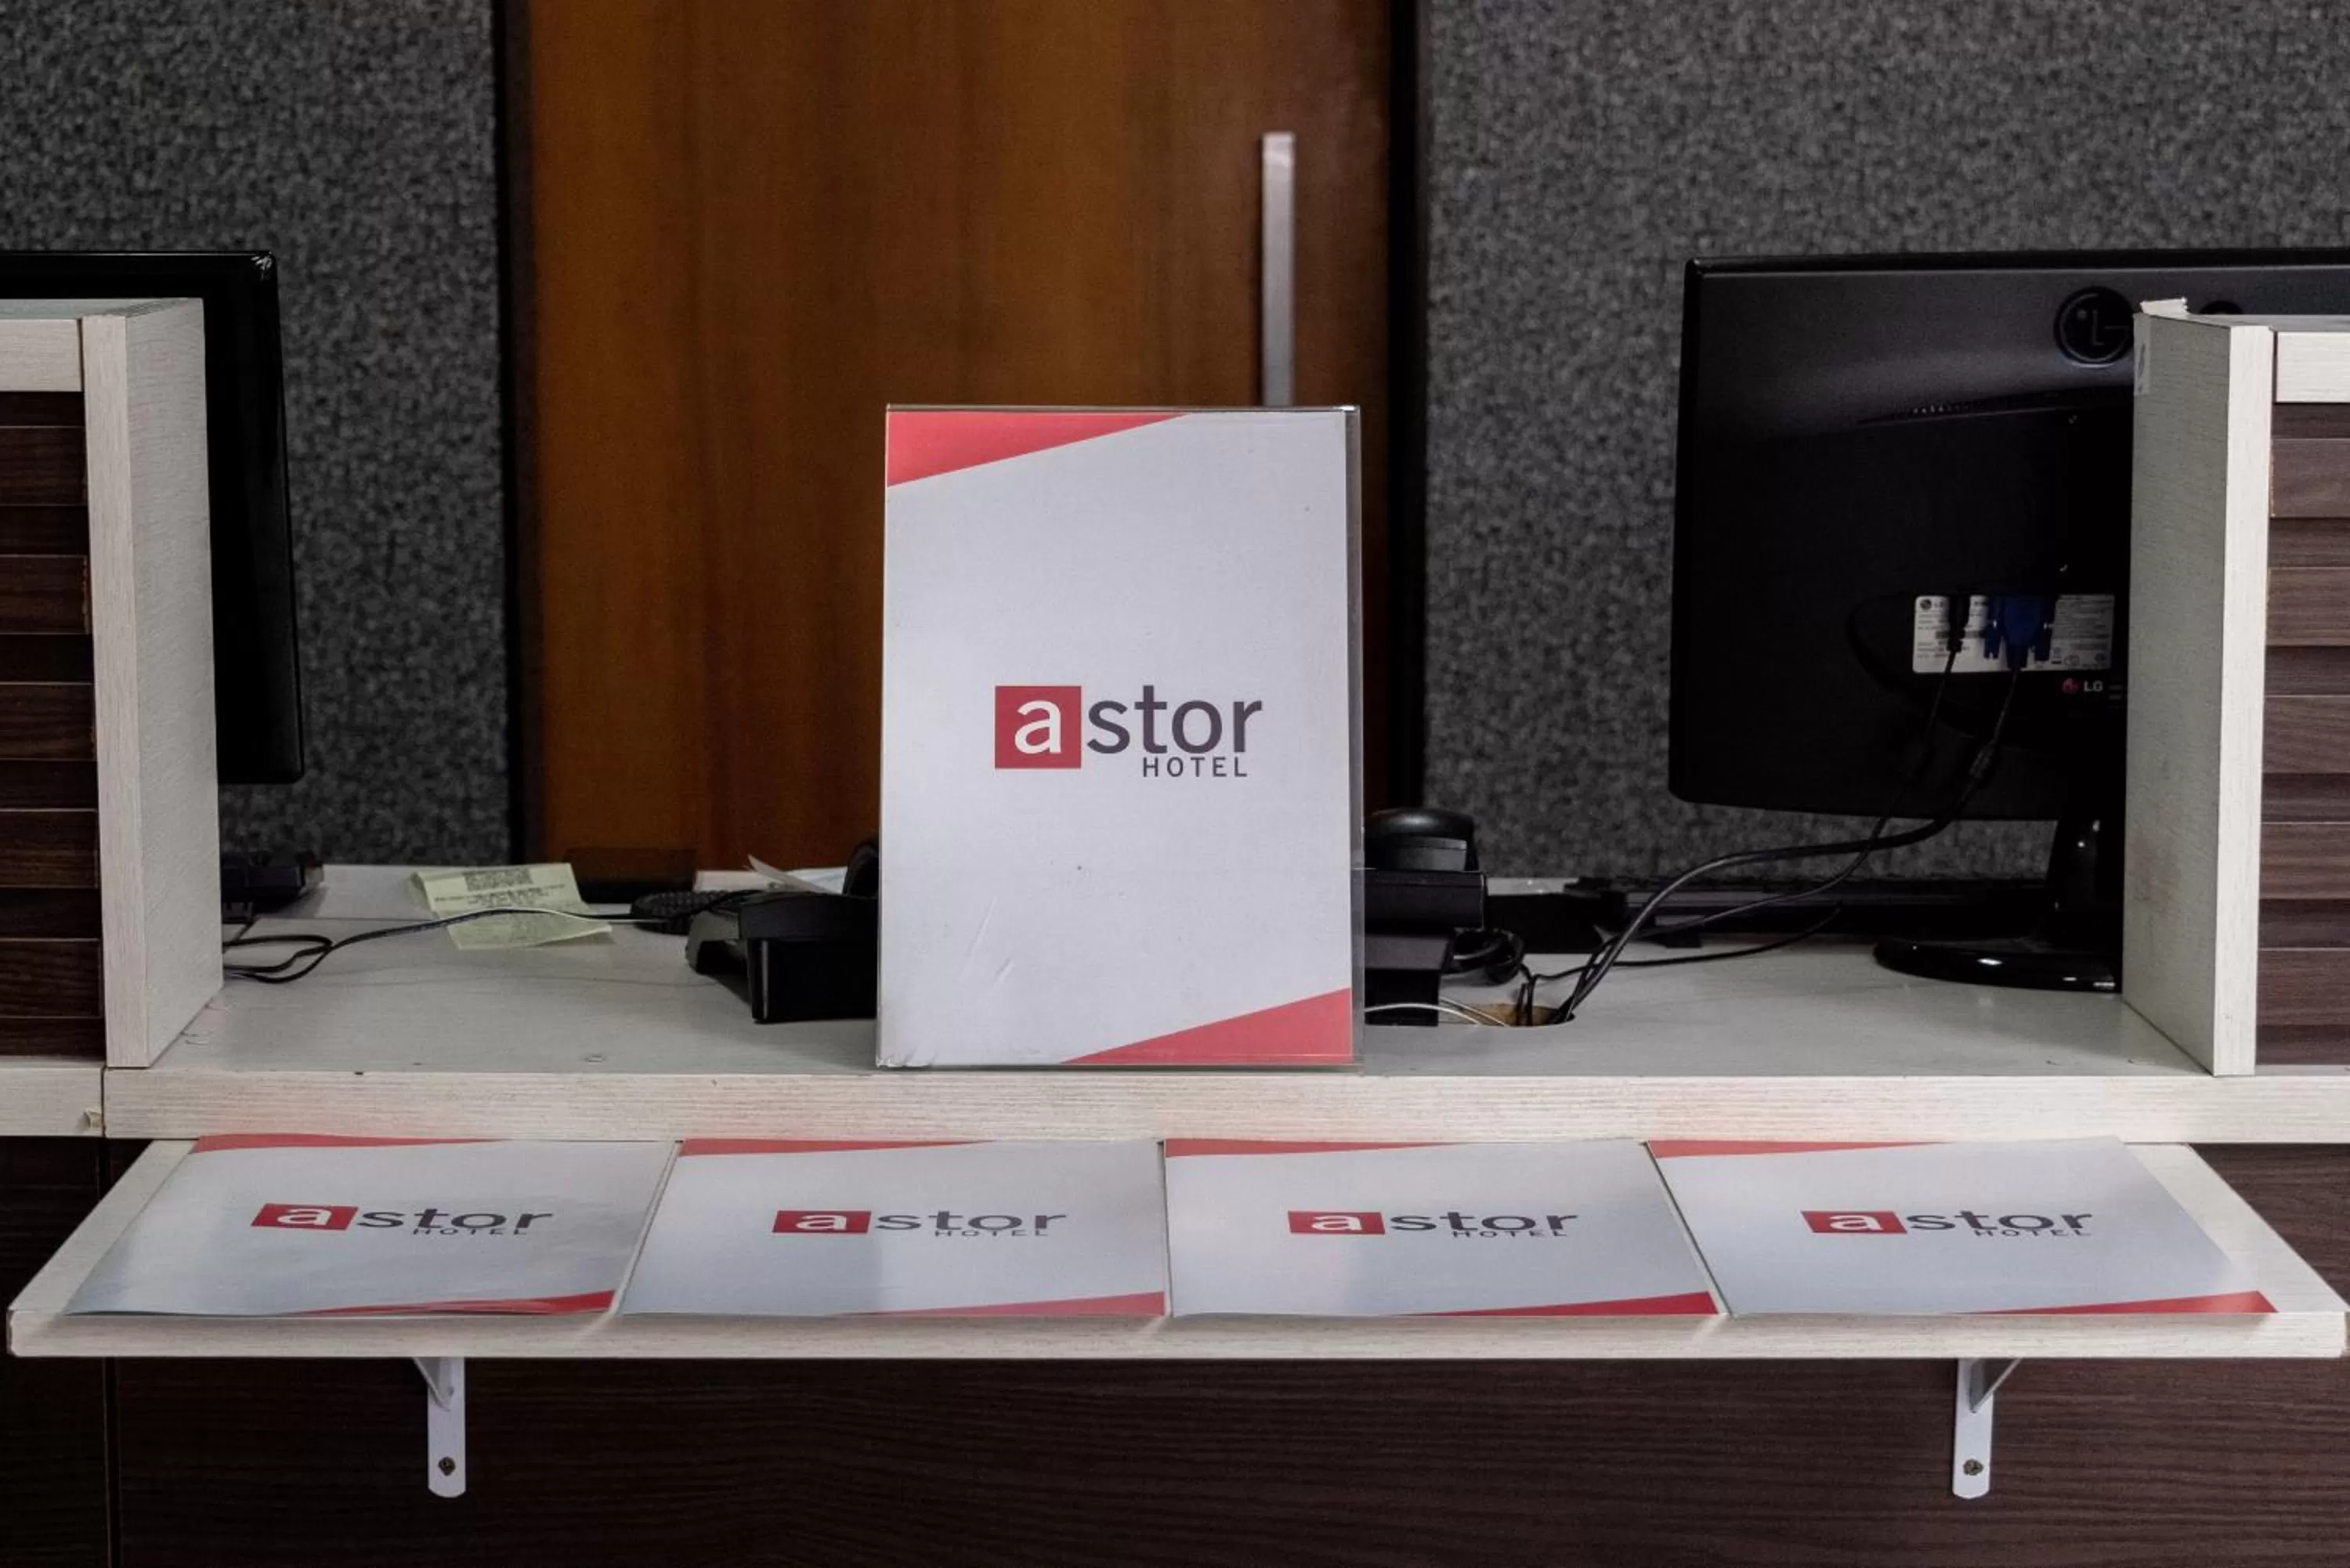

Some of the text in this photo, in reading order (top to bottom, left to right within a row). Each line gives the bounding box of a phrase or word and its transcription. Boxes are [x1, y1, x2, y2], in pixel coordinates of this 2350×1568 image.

[2084, 680, 2103, 692] LG
[1014, 685, 1263, 754] astor
[1143, 757, 1248, 778] HOTEL
[277, 1208, 554, 1229] astor
[796, 1210, 1067, 1232] astor
[1311, 1211, 1578, 1232] astor
[1829, 1210, 2092, 1231] astor
[1452, 1230, 1568, 1238] HOTEL
